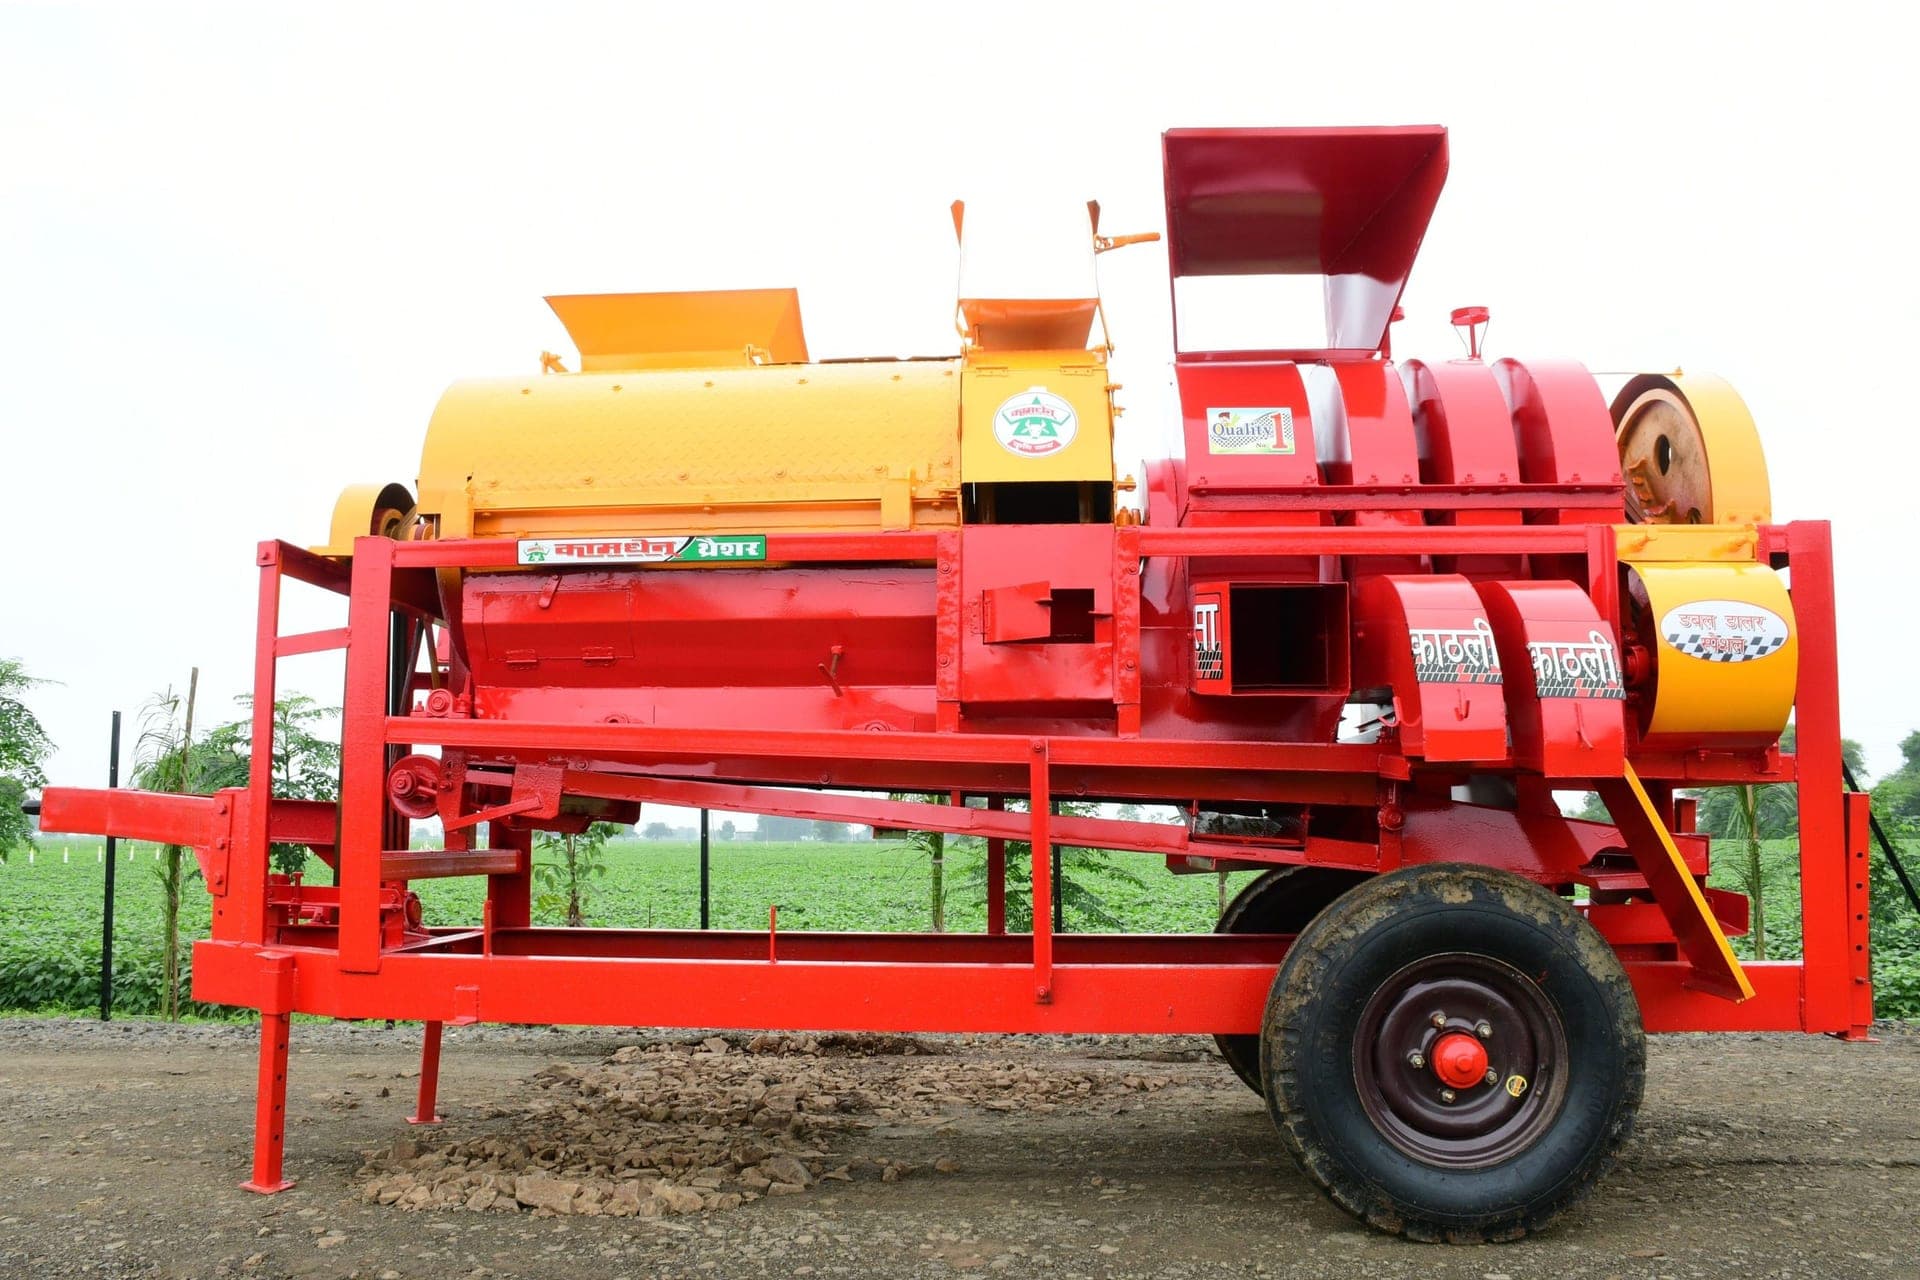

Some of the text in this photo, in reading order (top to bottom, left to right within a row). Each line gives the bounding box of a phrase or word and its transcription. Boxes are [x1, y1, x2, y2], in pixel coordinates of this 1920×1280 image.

[1212, 423, 1273, 440] Quality
[1270, 413, 1288, 448] 1
[1679, 614, 1766, 632] डबल डालर
[1409, 618, 1500, 669] काठली
[1527, 630, 1618, 685] काठली
